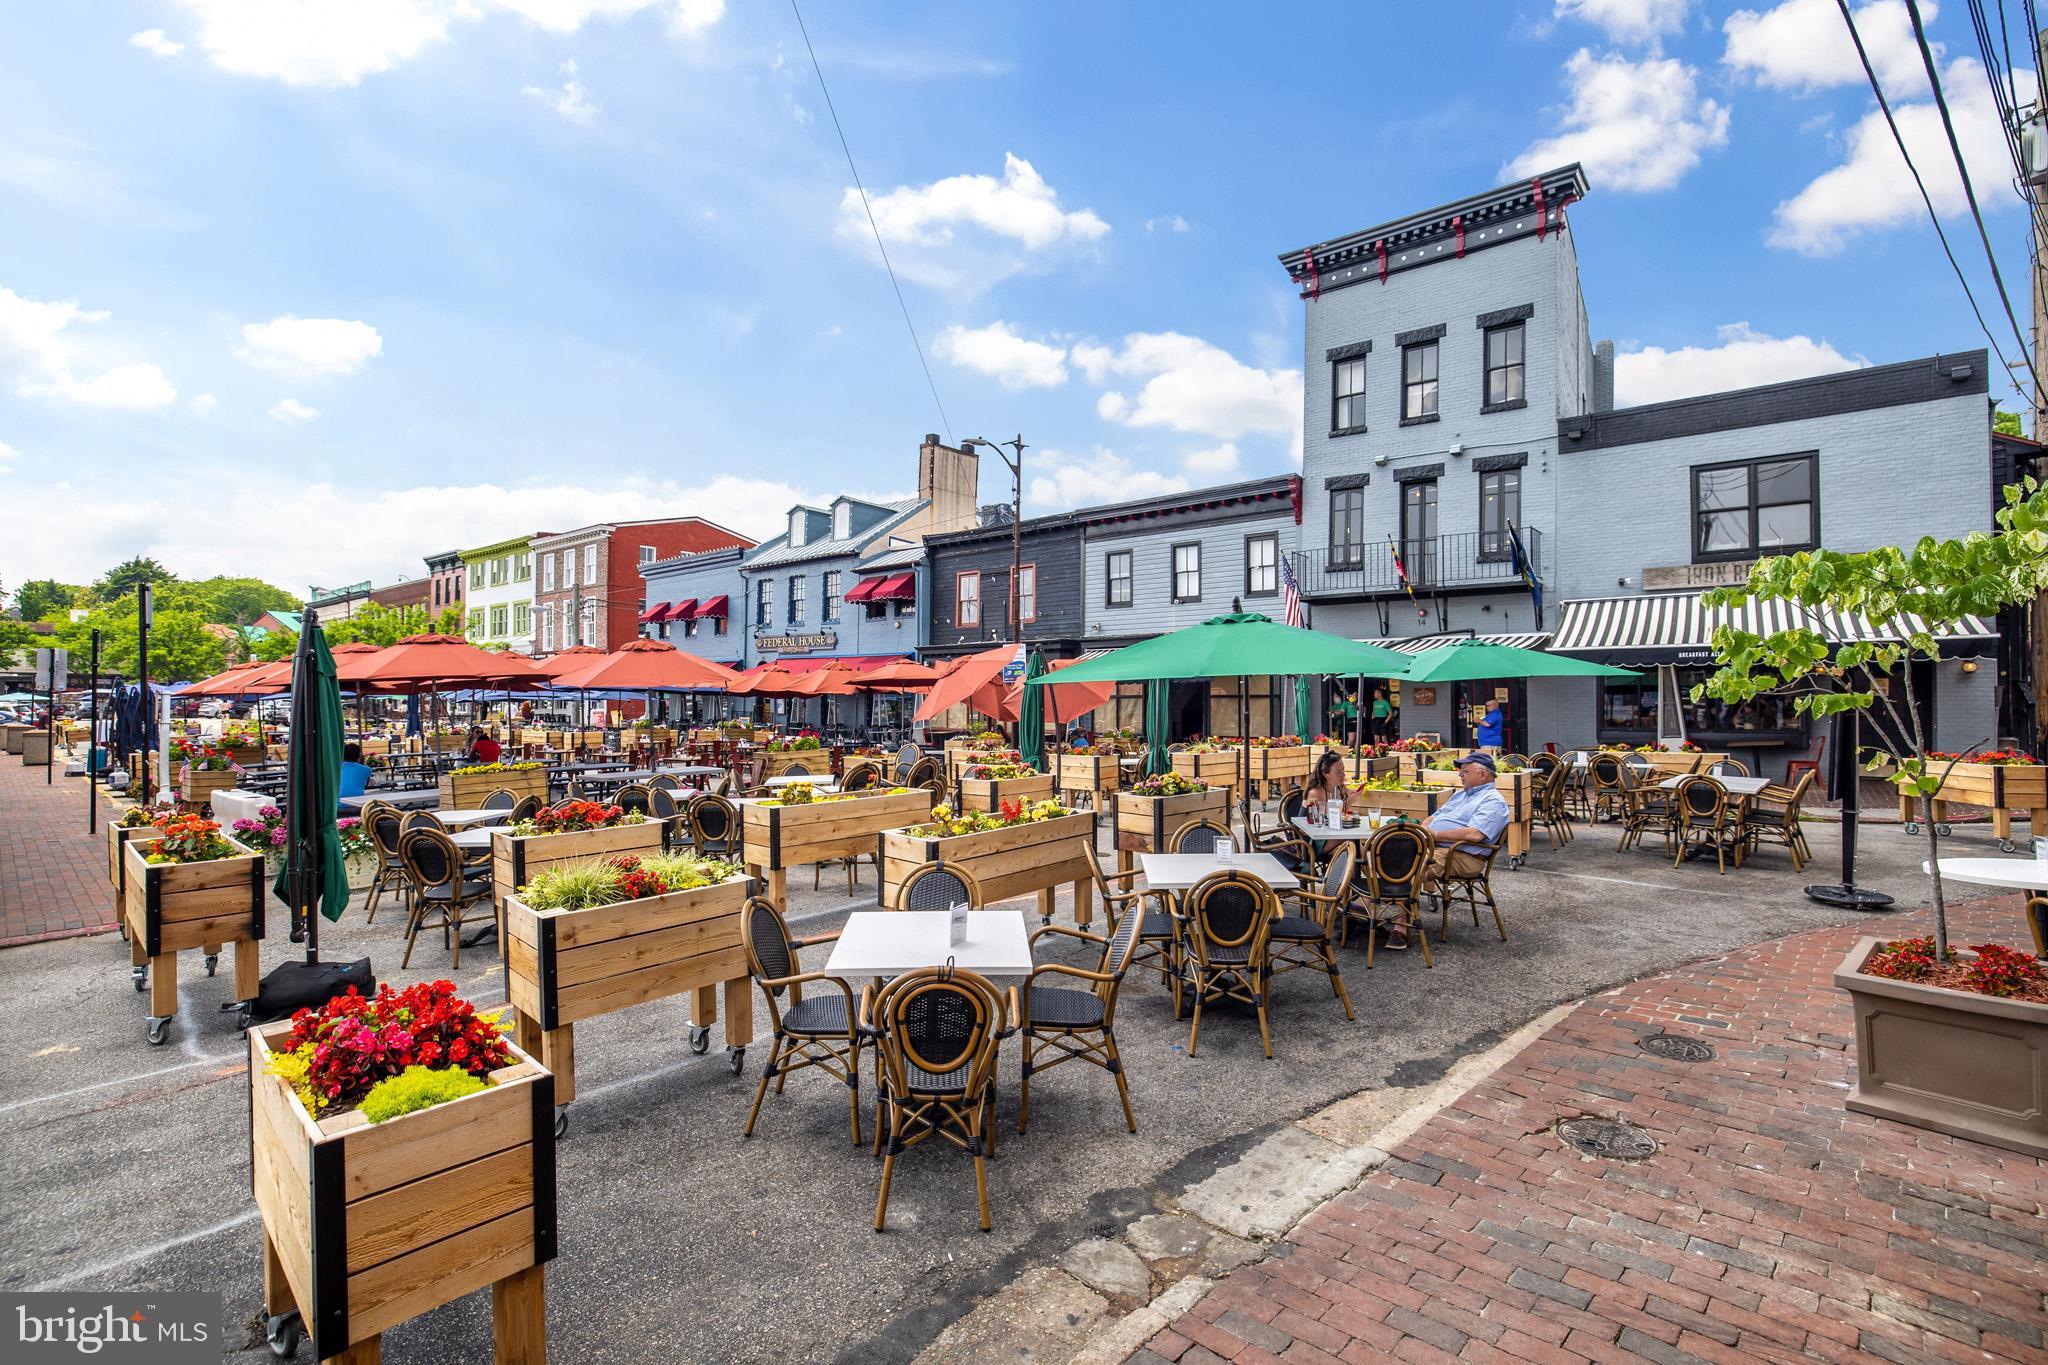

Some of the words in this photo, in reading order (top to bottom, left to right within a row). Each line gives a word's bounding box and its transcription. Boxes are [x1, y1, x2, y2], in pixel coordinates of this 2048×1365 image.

[1687, 565, 1726, 585] IRON
[763, 637, 797, 647] FEDERAL
[799, 635, 826, 646] HOUSE
